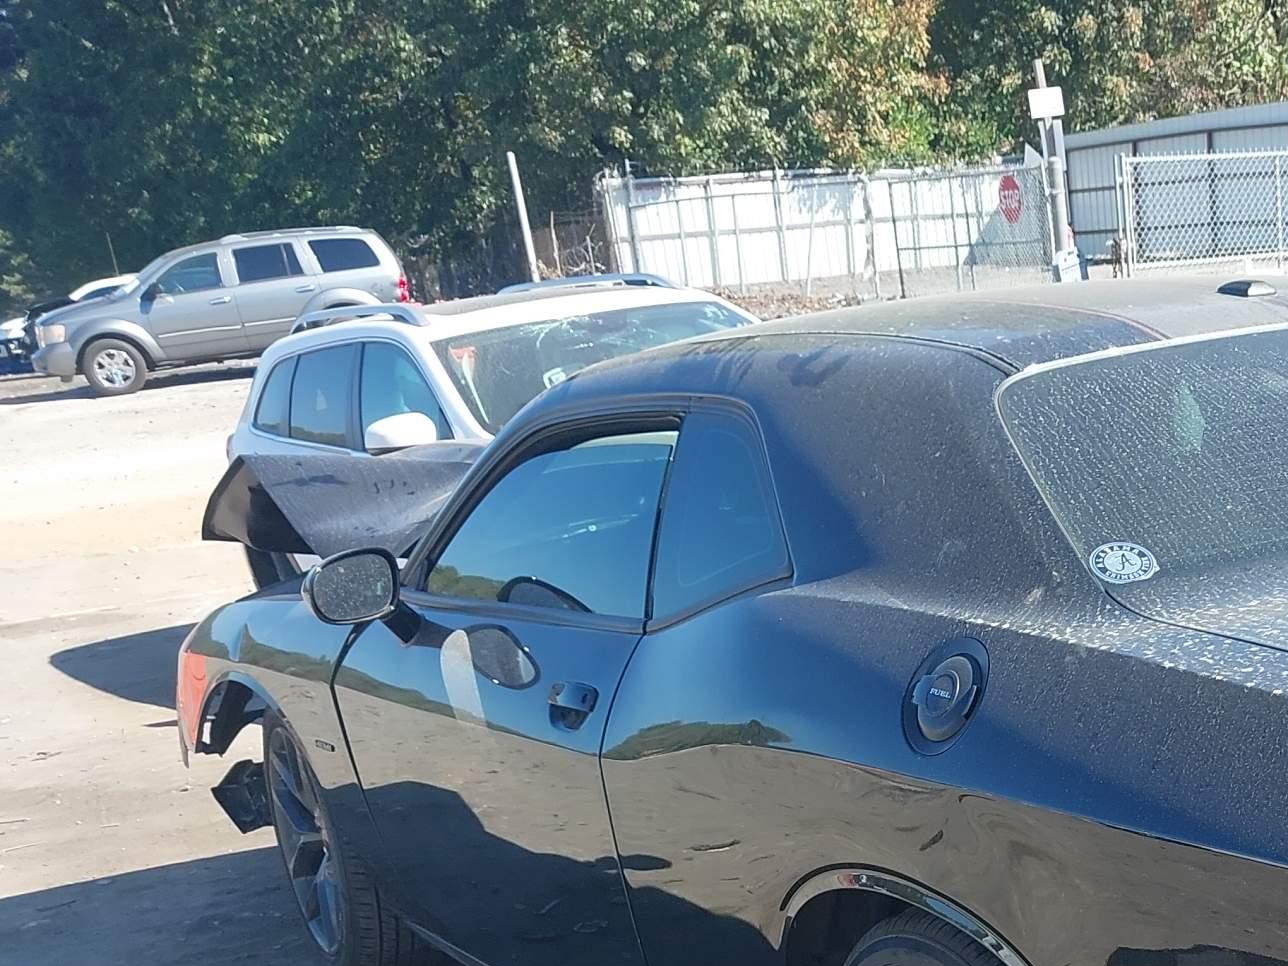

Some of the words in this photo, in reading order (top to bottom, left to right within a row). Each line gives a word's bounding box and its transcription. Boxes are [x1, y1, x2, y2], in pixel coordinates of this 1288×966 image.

[1001, 190, 1020, 209] STOP
[1096, 545, 1139, 568] ALABAMA
[1115, 552, 1137, 572] A
[1104, 569, 1145, 580] CRIMSON
[929, 687, 951, 699] FUEL
